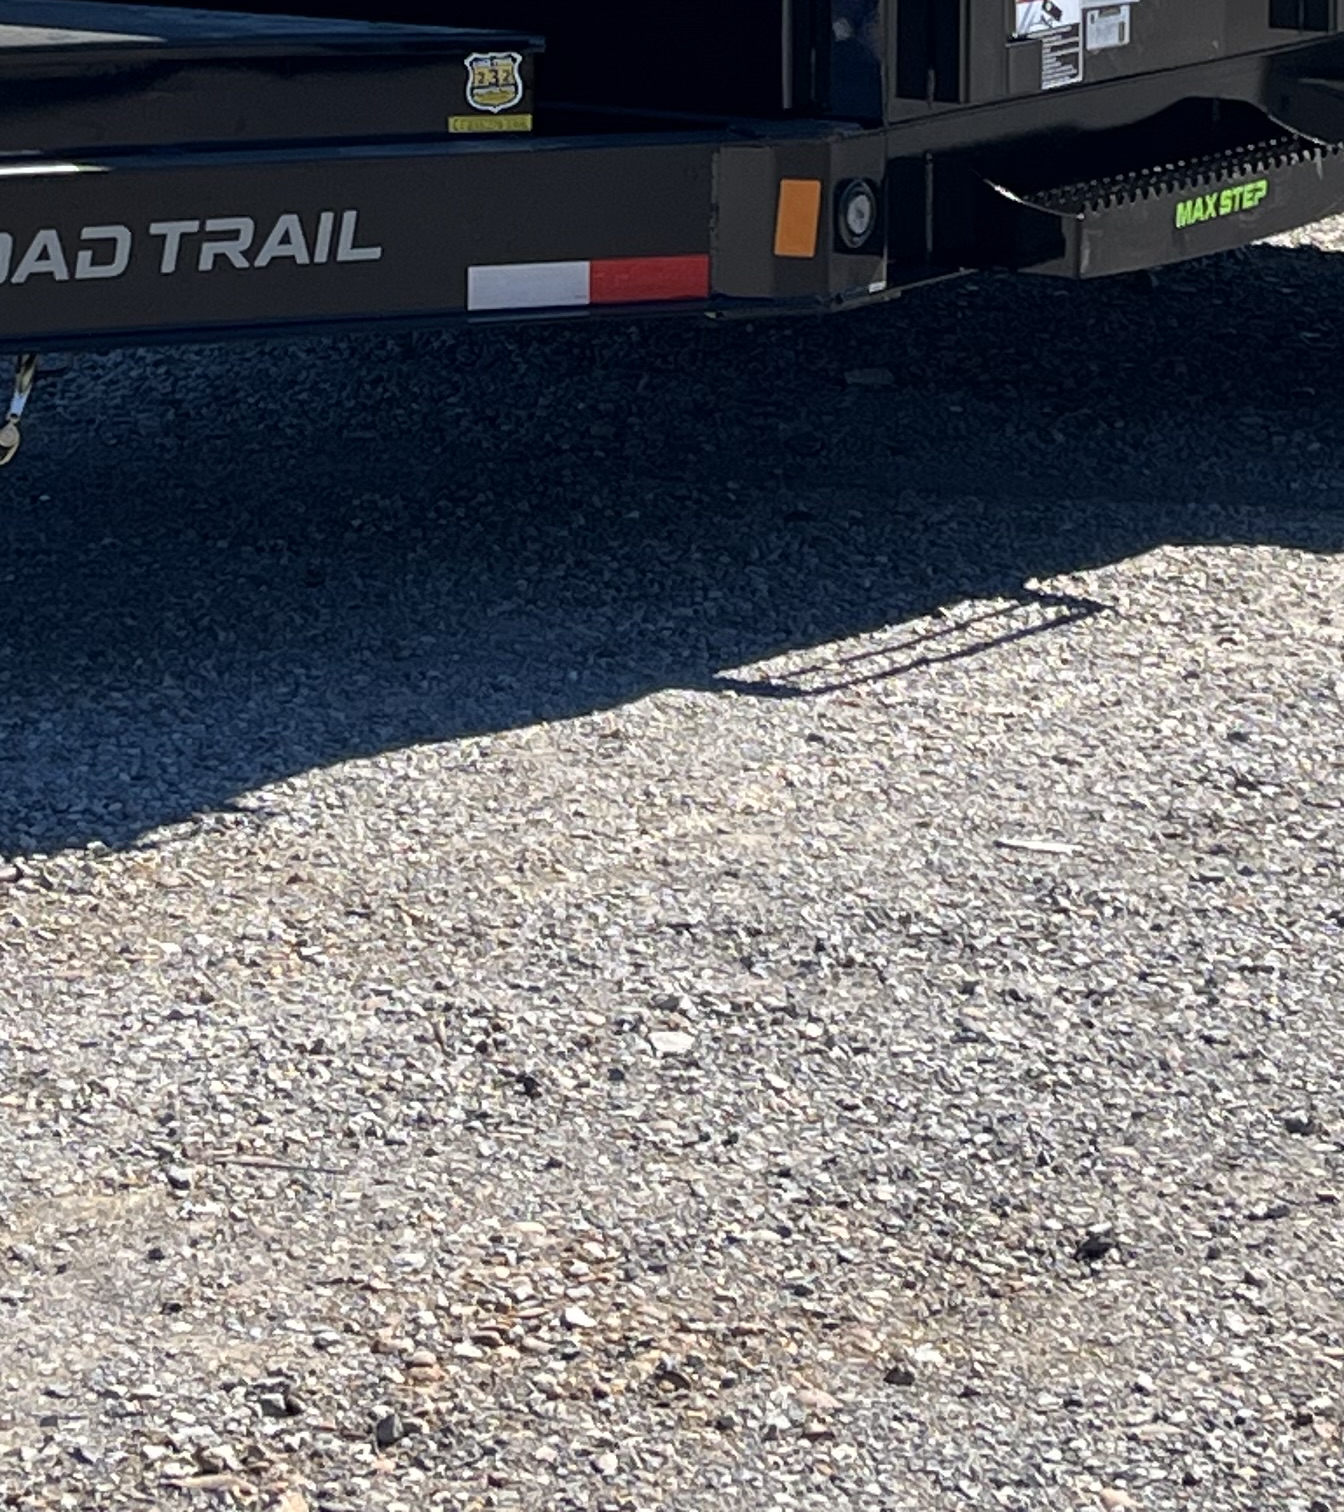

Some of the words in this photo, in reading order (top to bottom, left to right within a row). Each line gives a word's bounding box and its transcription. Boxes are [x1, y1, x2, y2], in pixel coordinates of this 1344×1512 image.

[1176, 192, 1218, 228] MAX
[1219, 179, 1268, 216] STEP
[149, 210, 383, 274] TRAIL
